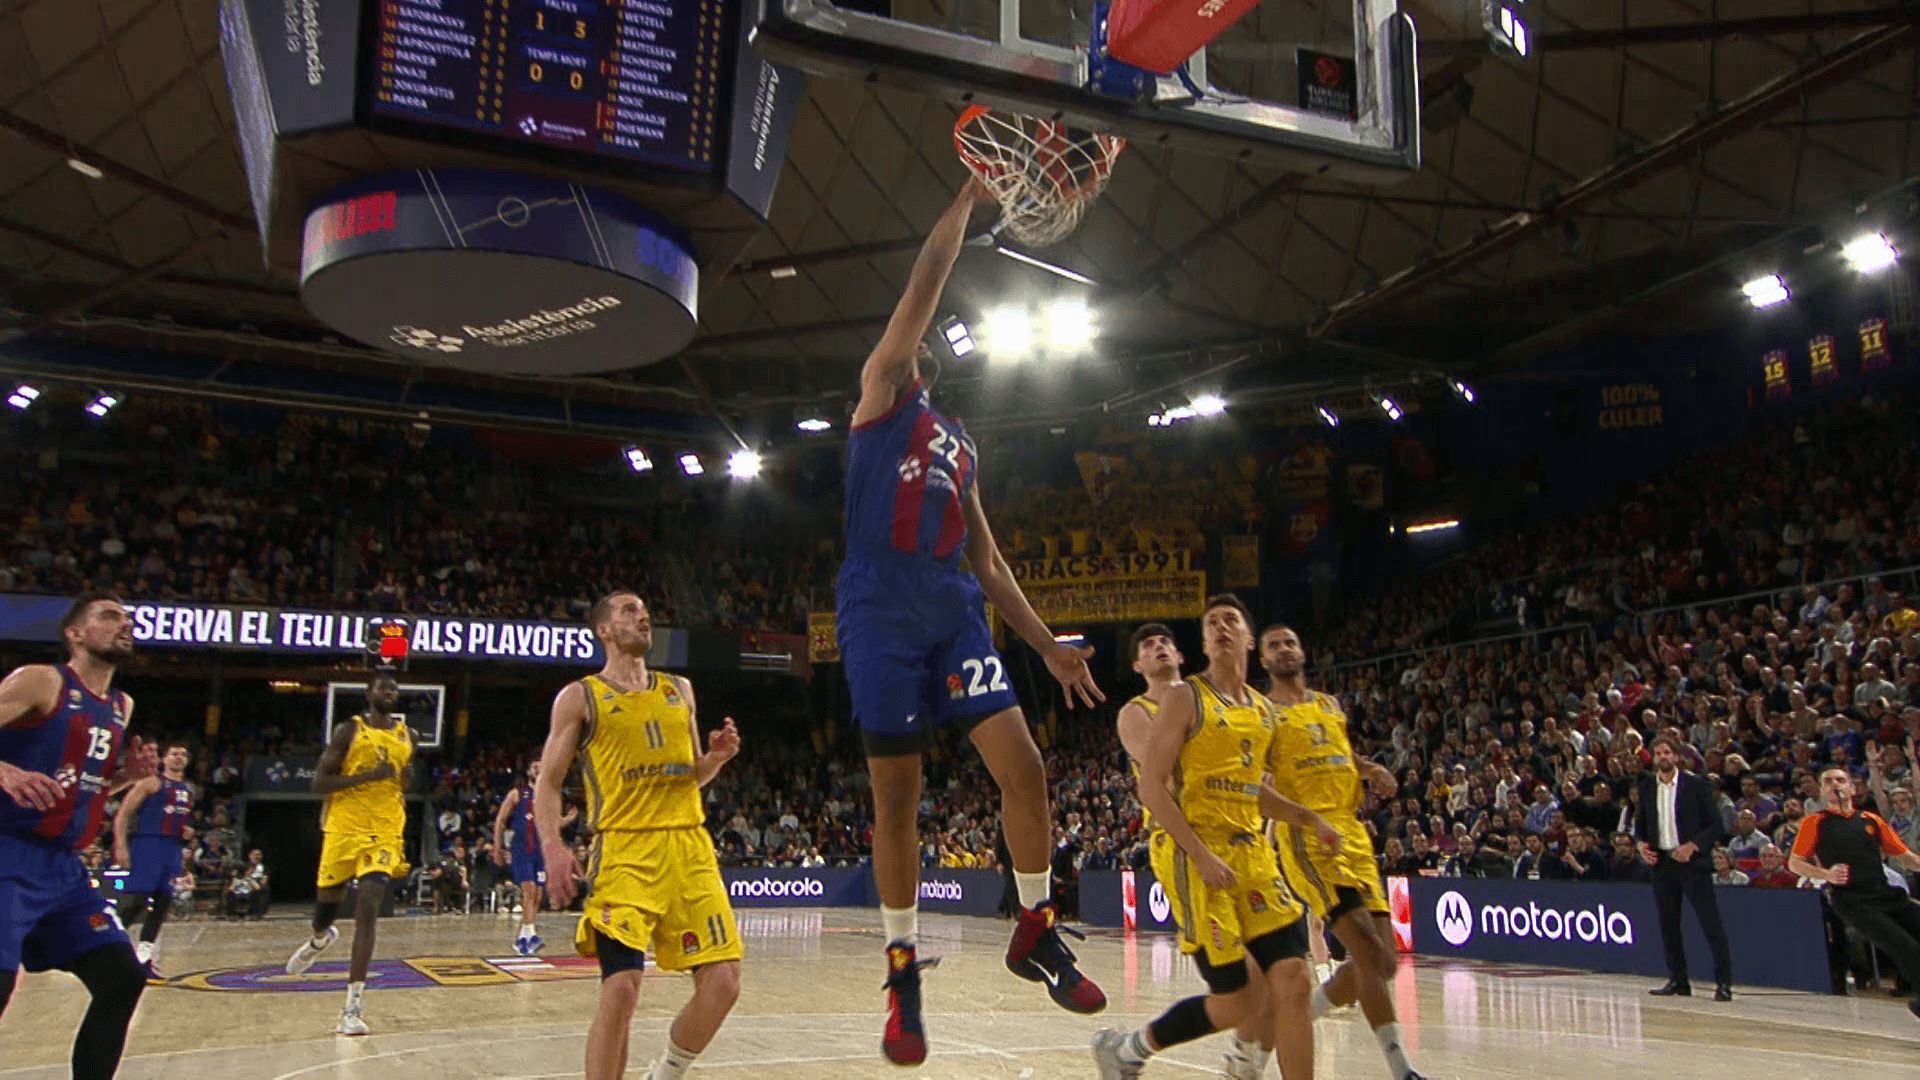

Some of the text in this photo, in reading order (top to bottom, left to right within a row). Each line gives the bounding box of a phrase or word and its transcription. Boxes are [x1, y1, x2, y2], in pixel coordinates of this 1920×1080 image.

[536, 11, 545, 31] 1
[529, 63, 583, 91] 0 0
[1810, 345, 1832, 369] 12
[1600, 384, 1661, 406] 100%
[928, 422, 960, 471] 22
[1119, 549, 1191, 575] 1991
[239, 610, 273, 645] EL
[279, 612, 334, 647] TEU
[410, 619, 464, 654] ALS
[467, 622, 595, 659] PLAYOFFS
[962, 655, 1009, 697] 22
[86, 726, 114, 761] 13
[645, 719, 664, 749] 11
[730, 876, 824, 897] motorola
[707, 913, 727, 946] 11
[1480, 900, 1634, 945] motorola
